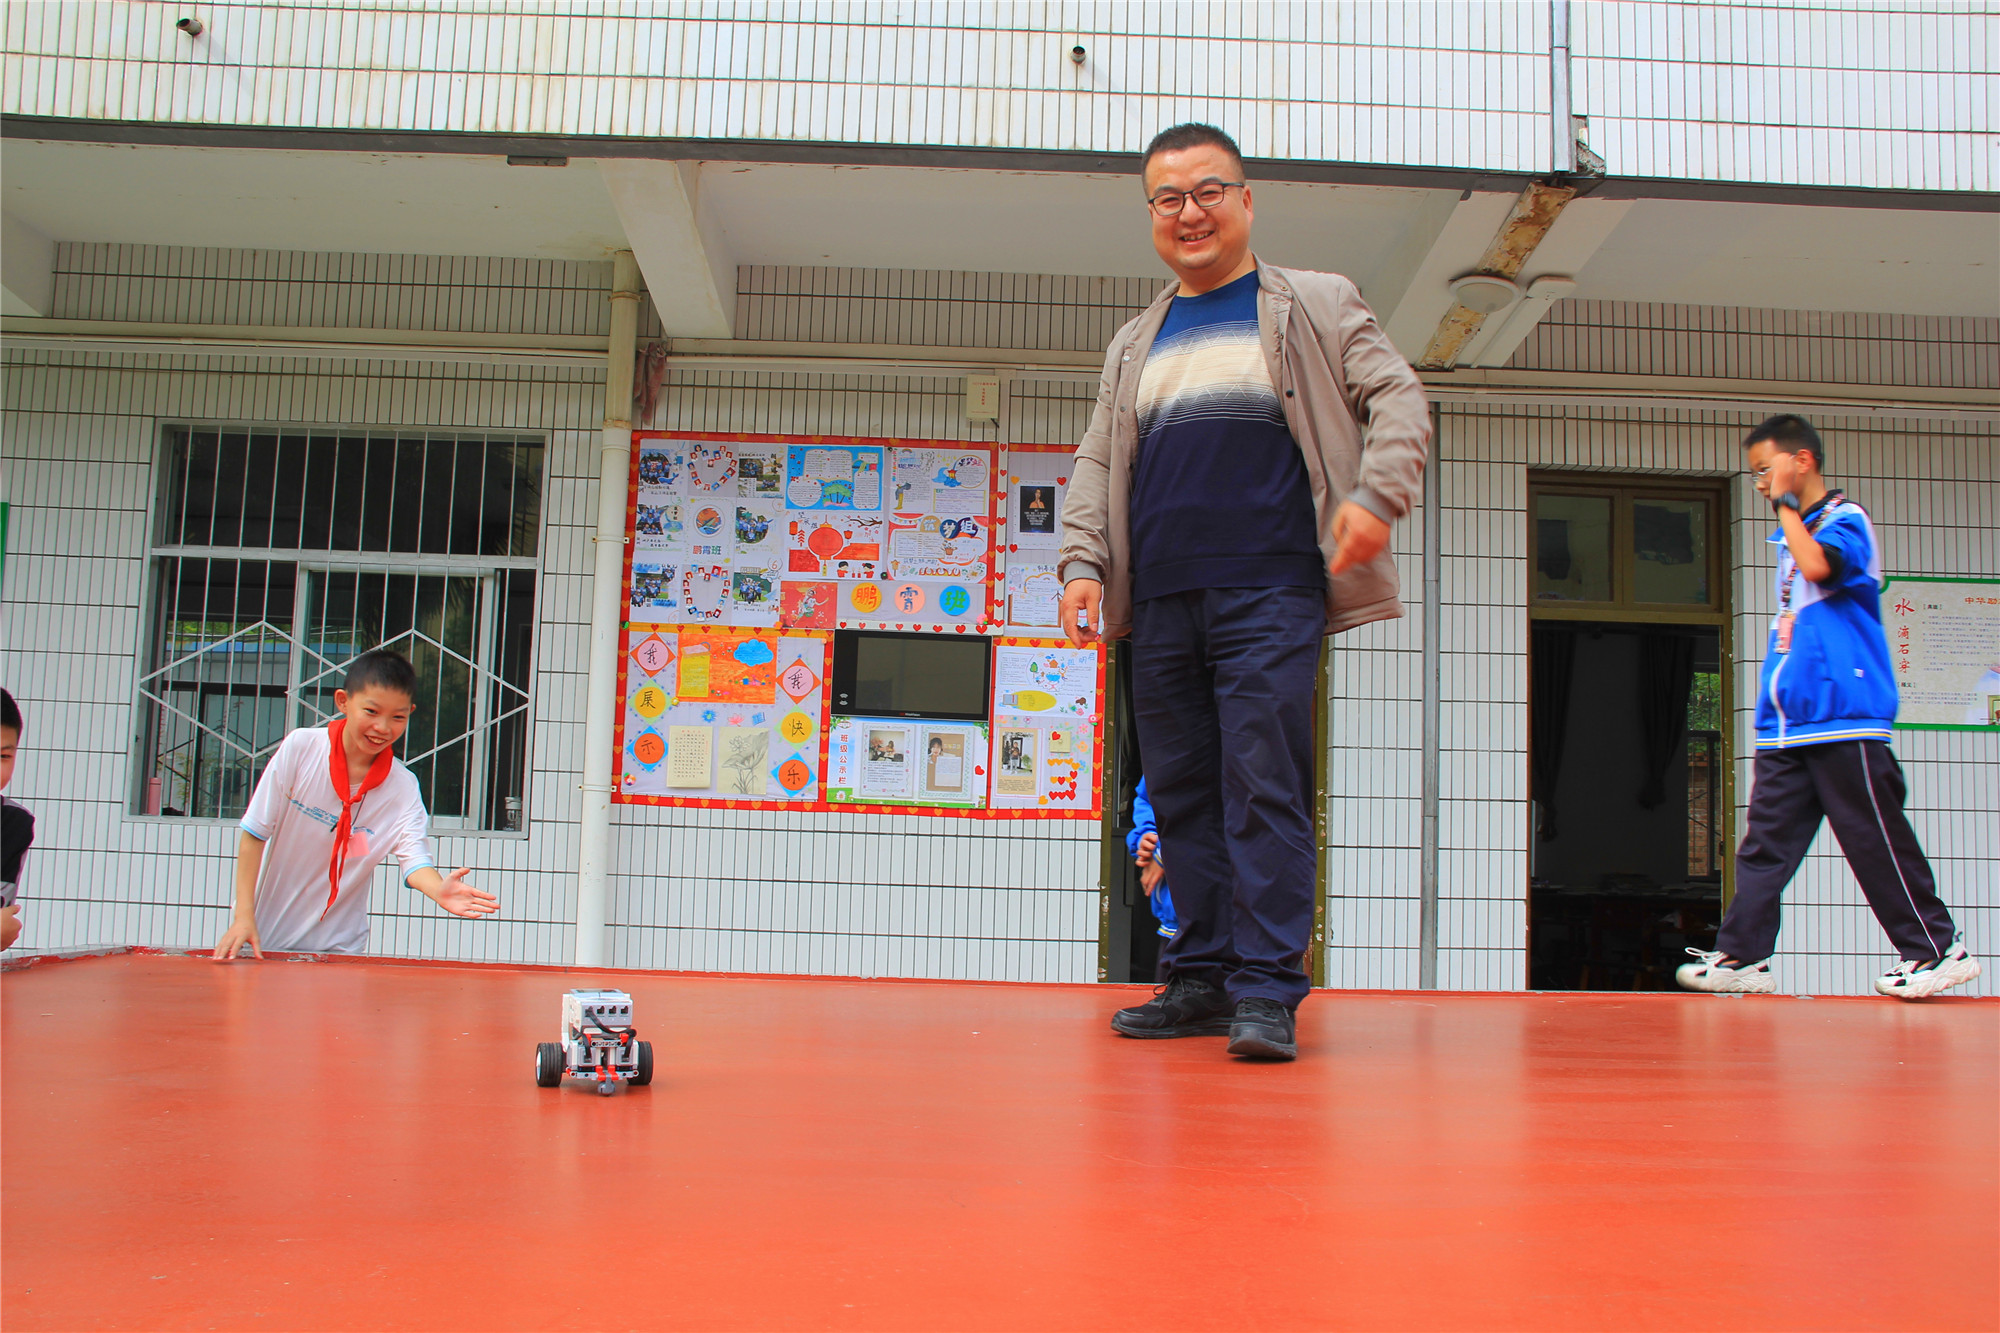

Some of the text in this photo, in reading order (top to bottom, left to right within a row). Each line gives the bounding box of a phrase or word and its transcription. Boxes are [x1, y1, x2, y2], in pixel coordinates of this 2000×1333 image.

[855, 586, 966, 612] 鹏霄班
[1894, 597, 1915, 673] 水滴石穿
[838, 734, 849, 785] 班级公示栏
